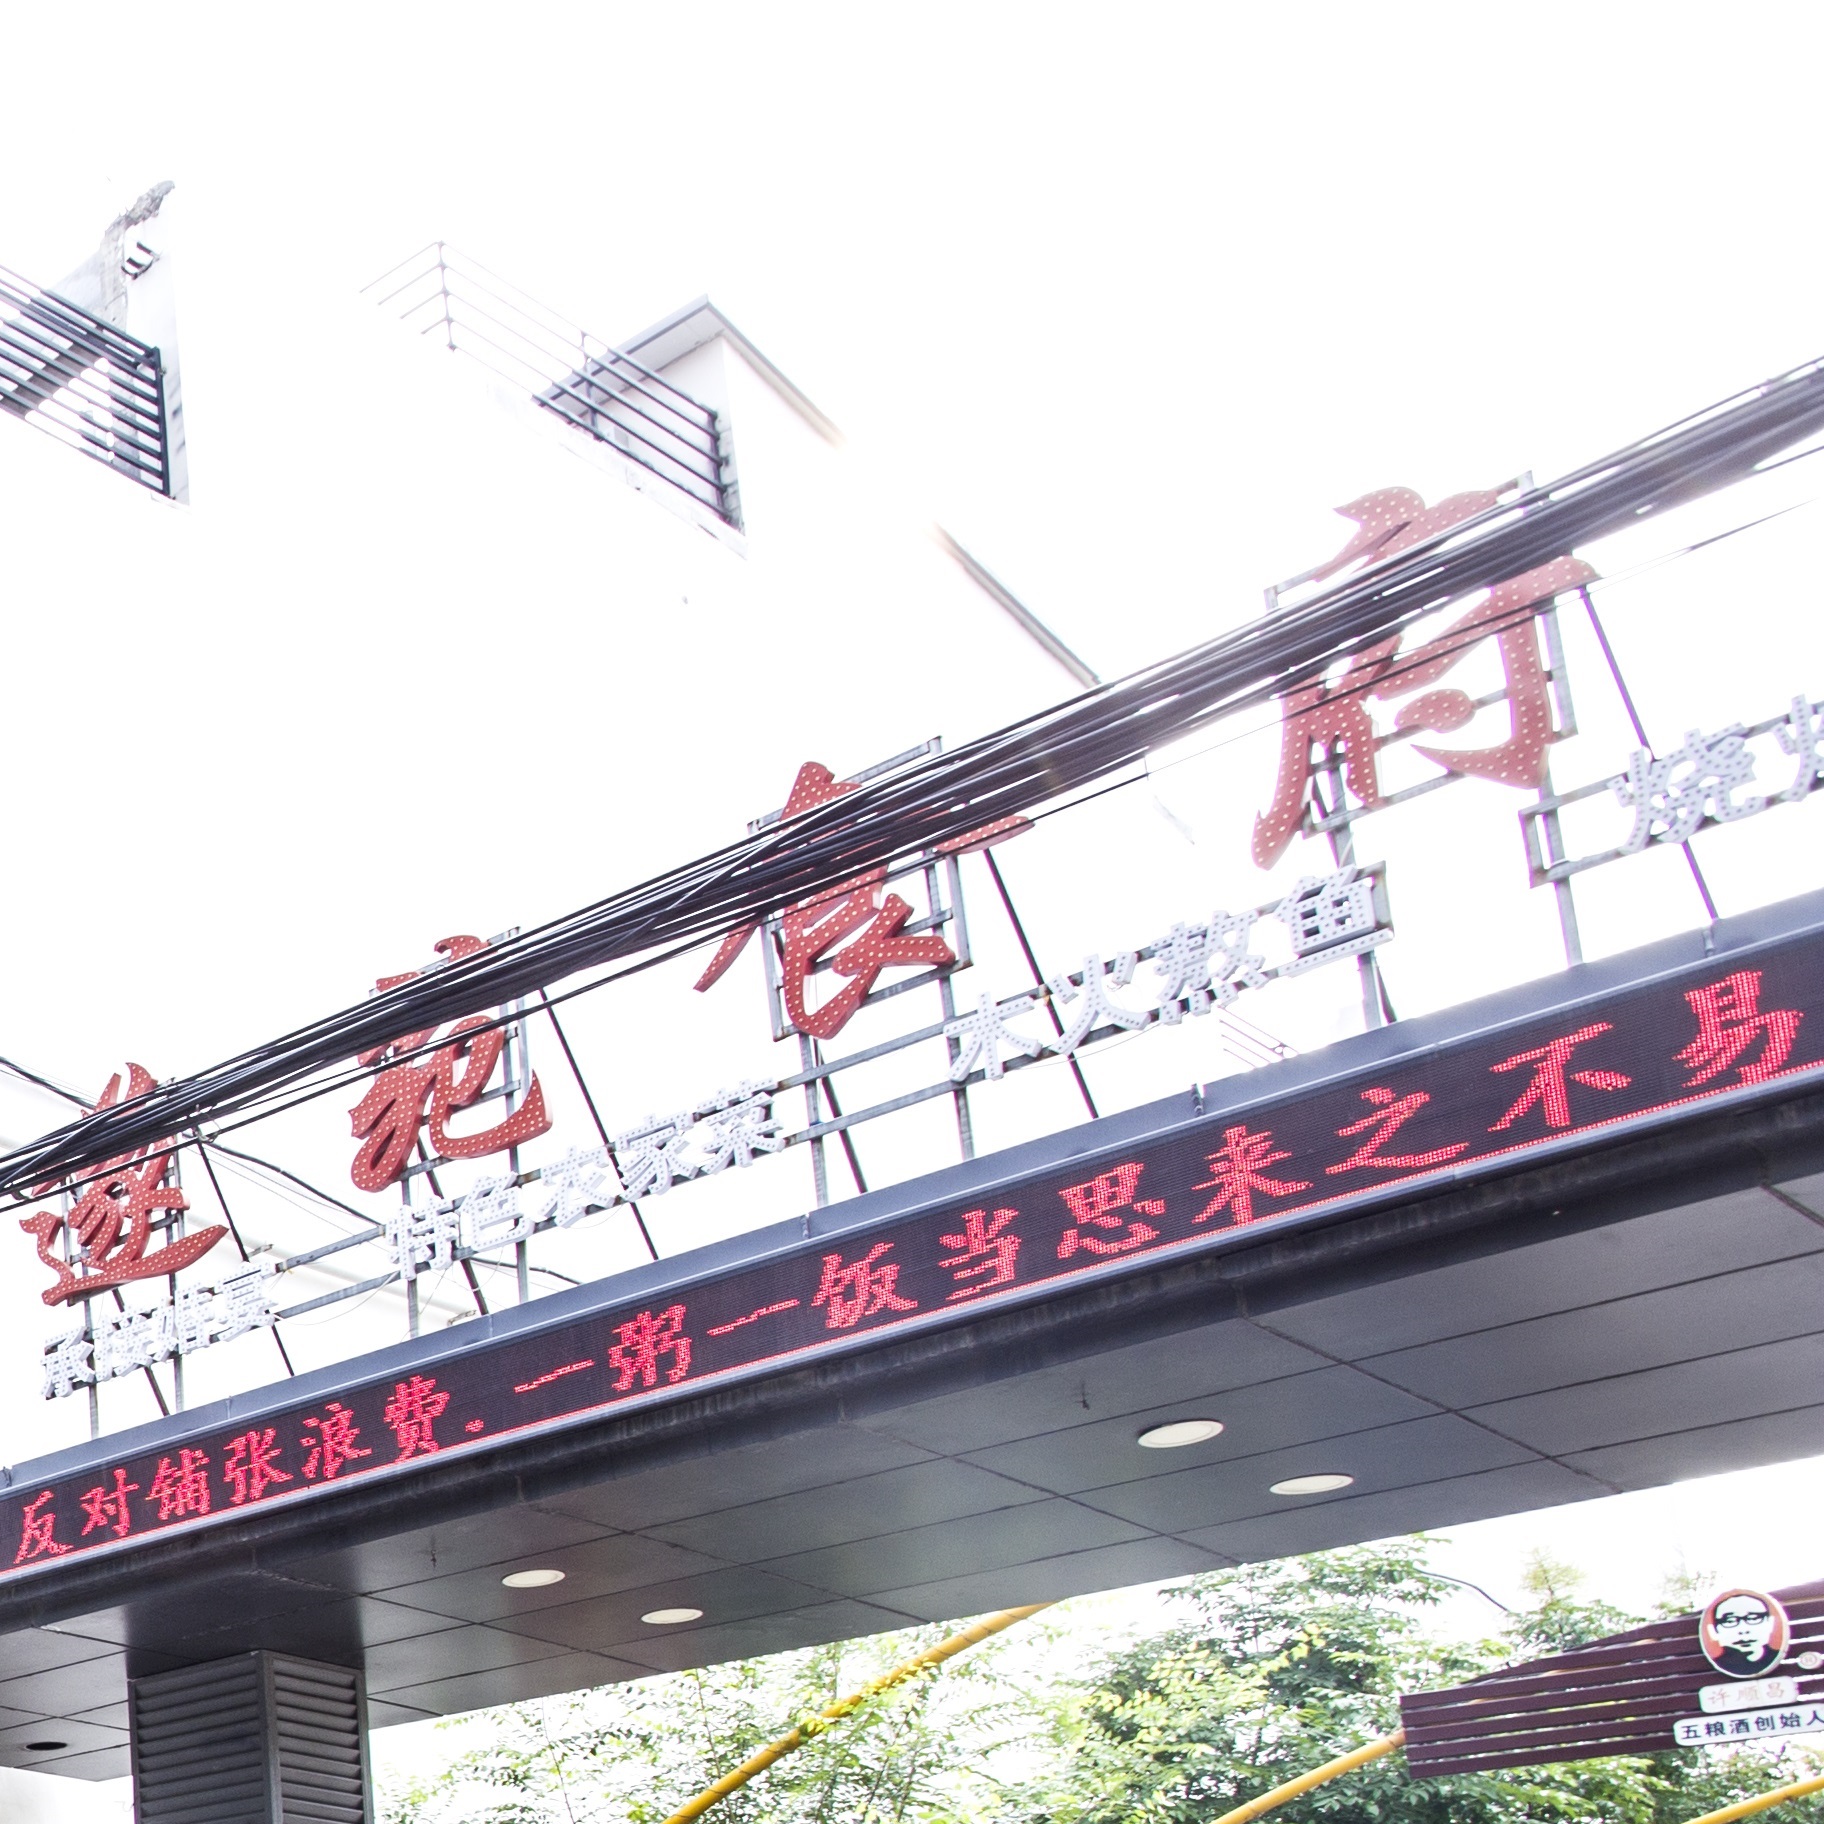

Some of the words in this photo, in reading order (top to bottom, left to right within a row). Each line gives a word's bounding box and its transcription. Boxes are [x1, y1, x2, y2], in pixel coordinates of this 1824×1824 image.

[384, 1078, 786, 1281] 特色农家菜
[39, 1261, 280, 1398] 承接婚宴
[1681, 1709, 1824, 1741] 五粮酒创始人
